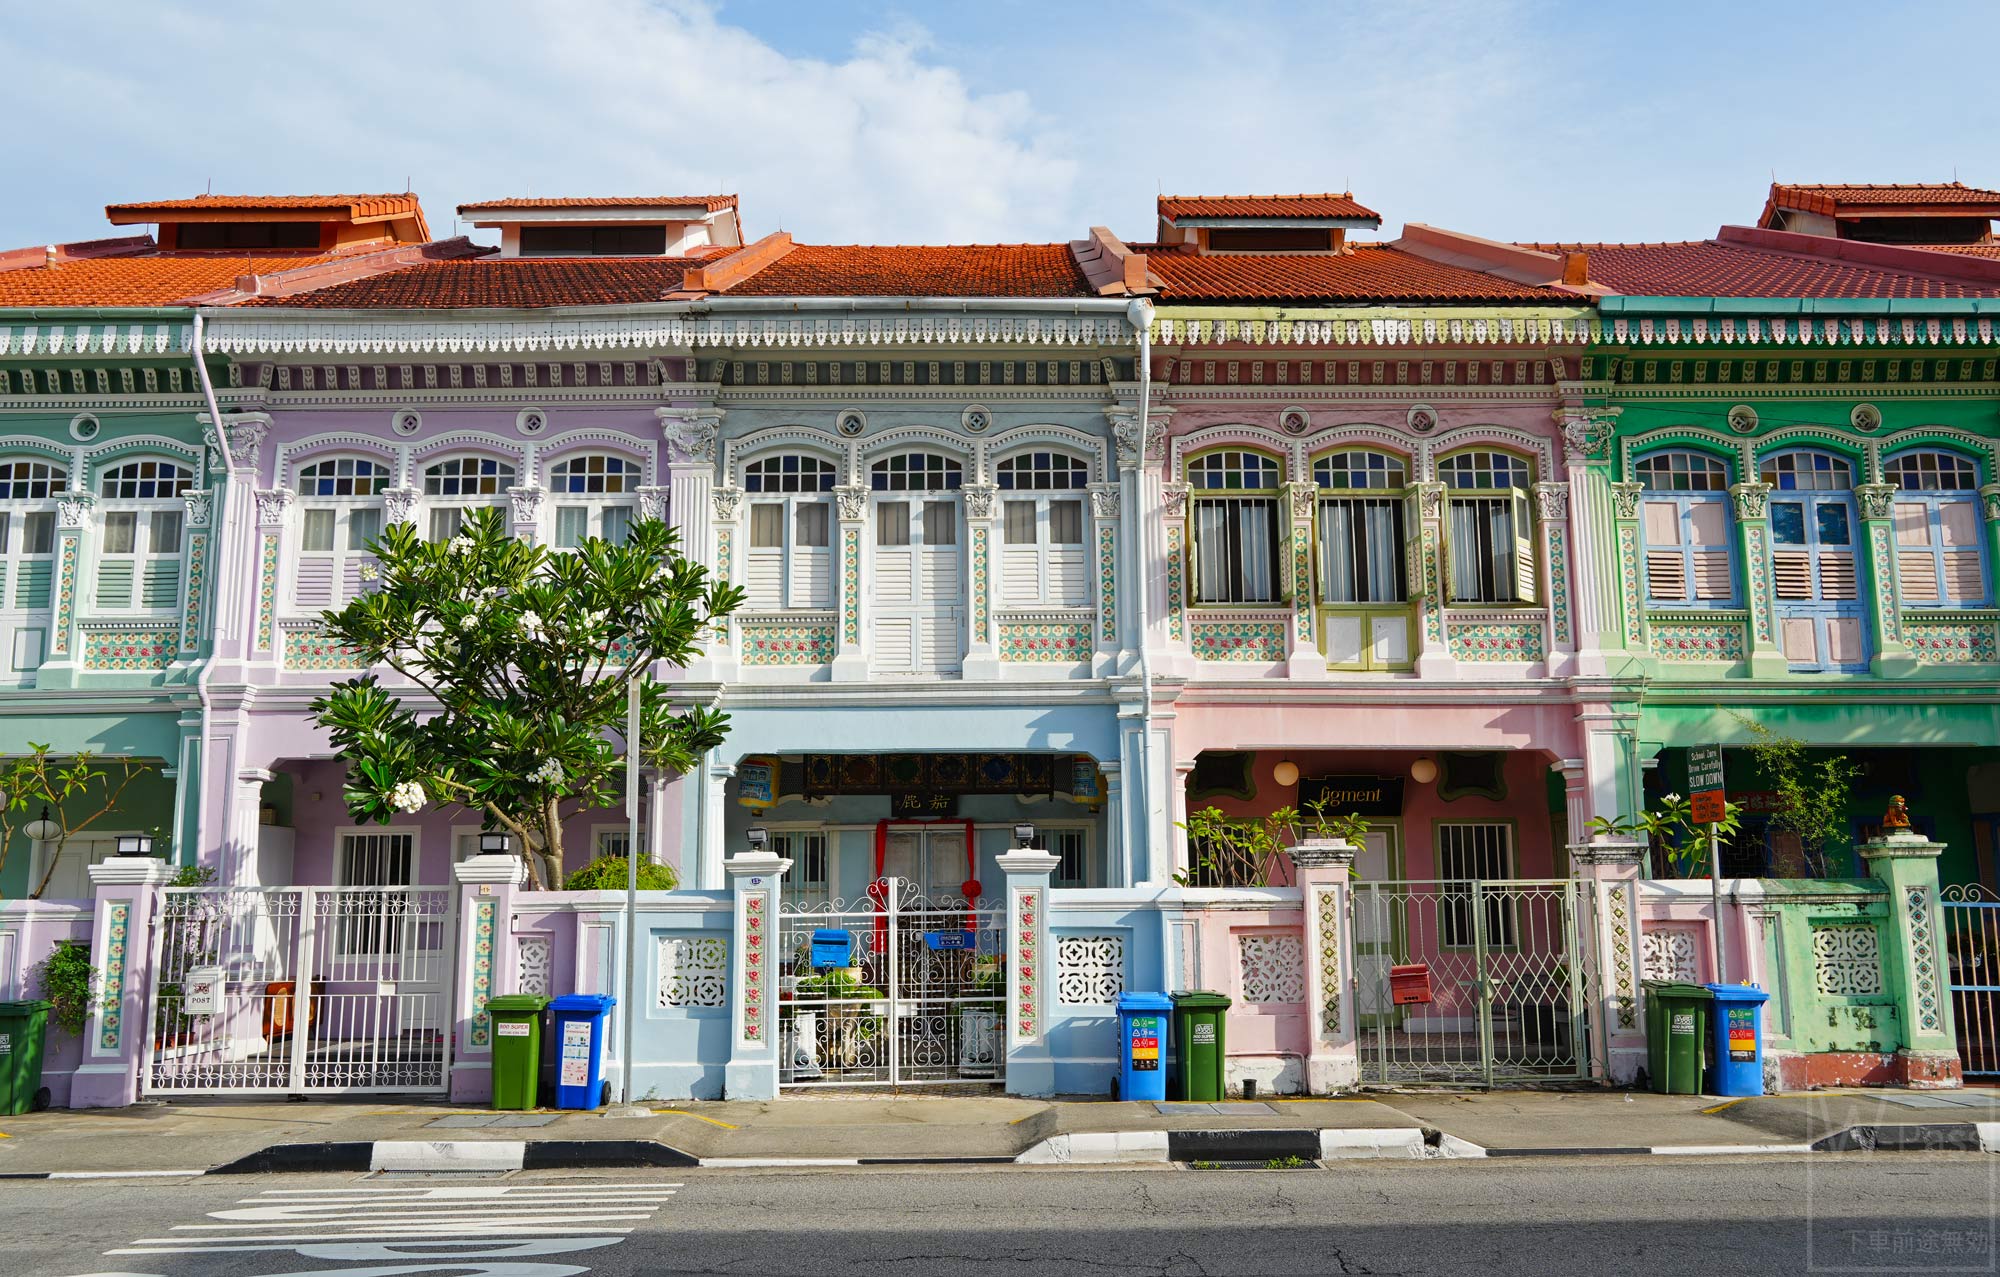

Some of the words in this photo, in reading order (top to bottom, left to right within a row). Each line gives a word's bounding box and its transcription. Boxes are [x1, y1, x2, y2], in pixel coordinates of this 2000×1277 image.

[1689, 774, 1705, 788] SLOW
[1705, 771, 1722, 786] DOWN
[1320, 785, 1382, 807] figment
